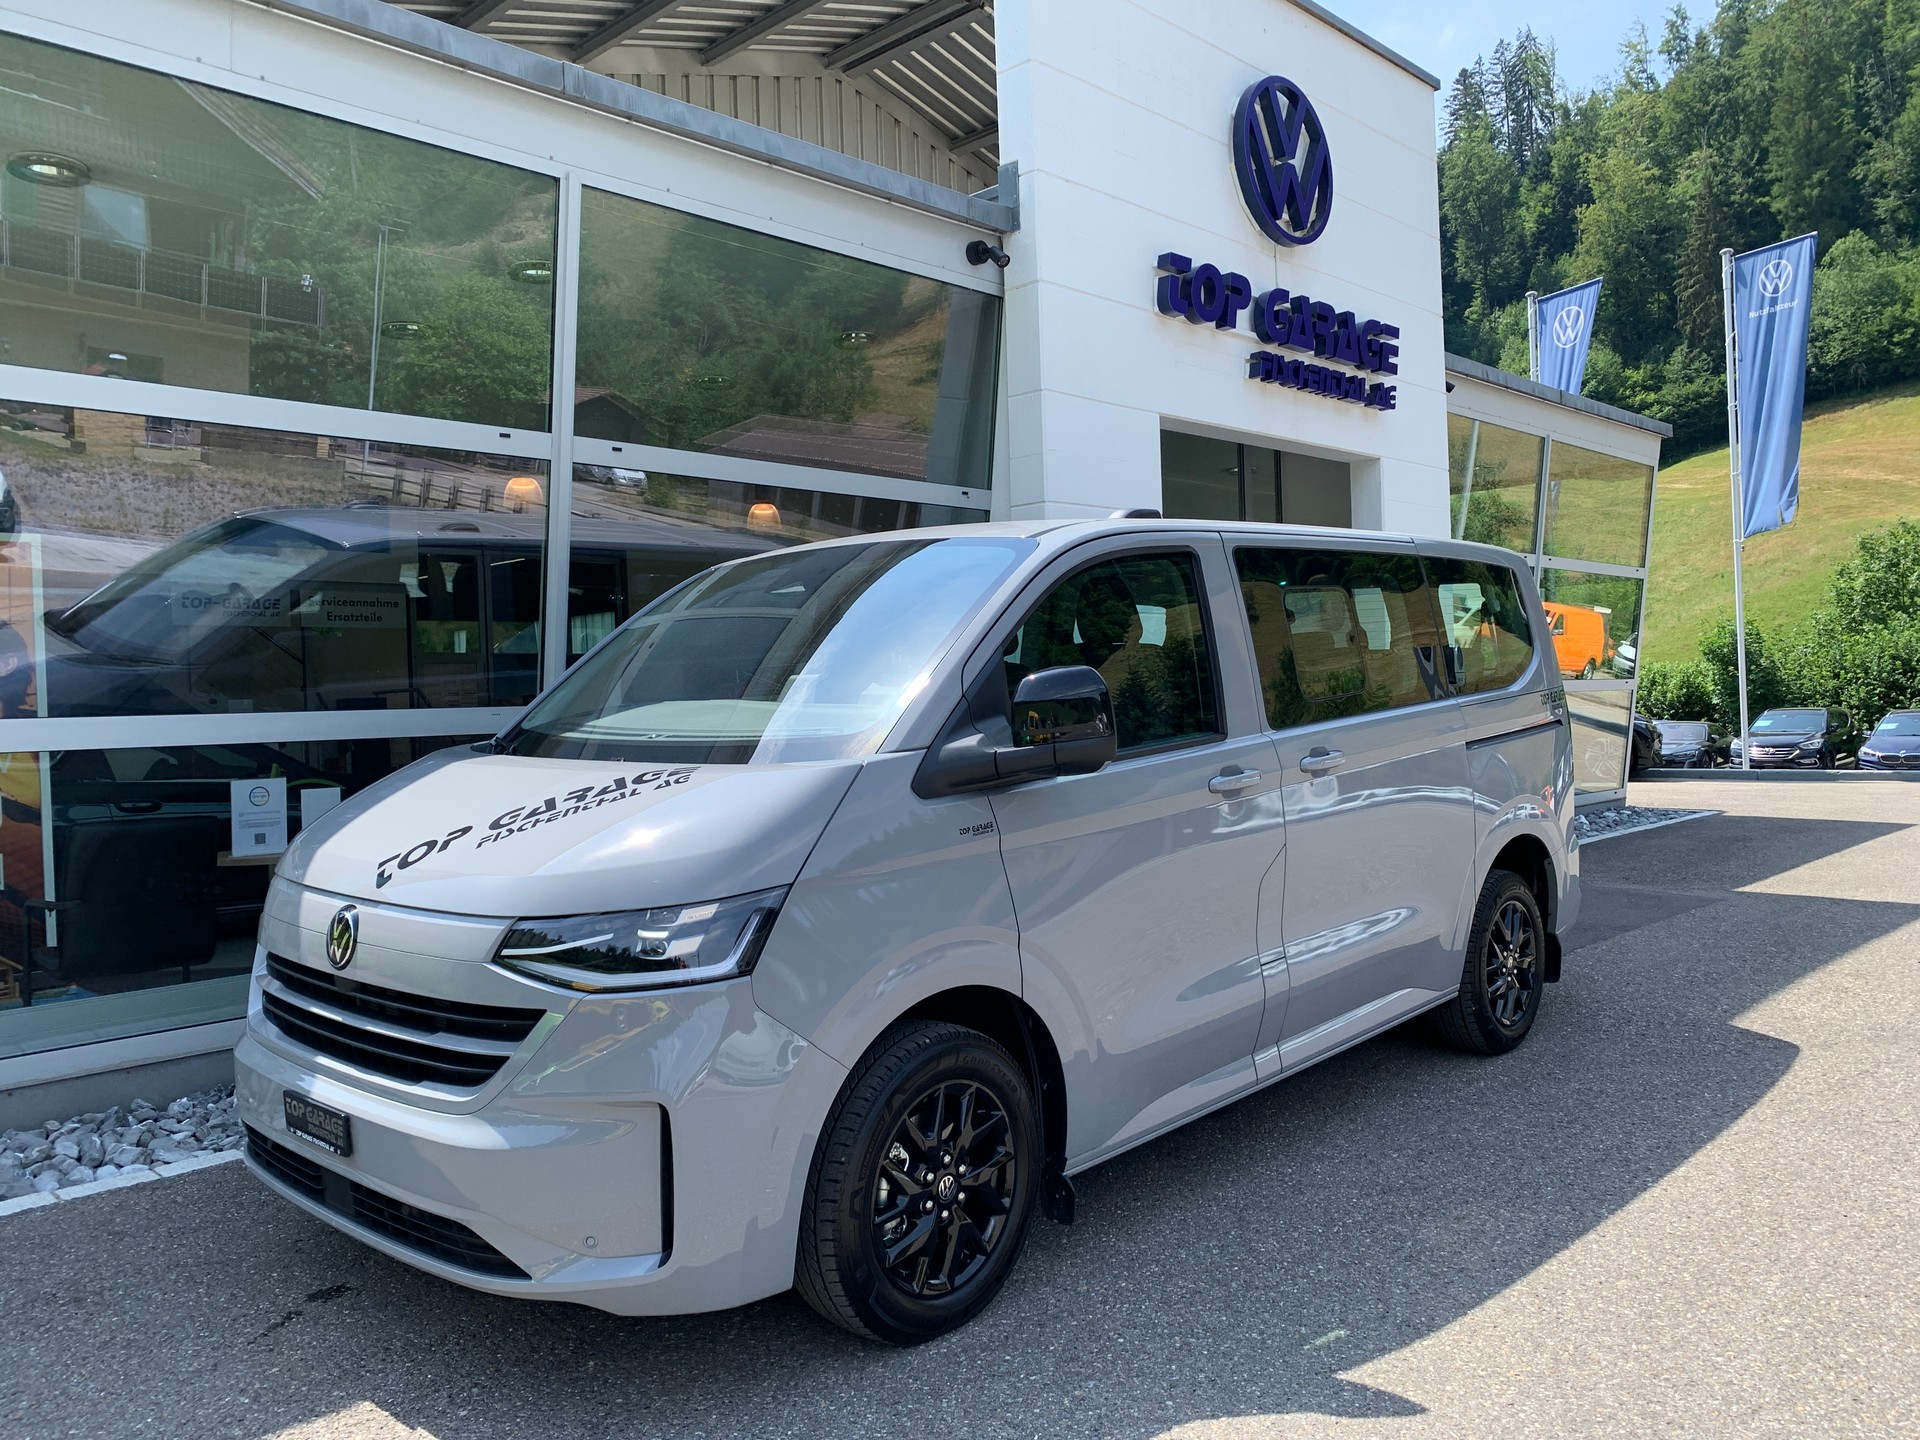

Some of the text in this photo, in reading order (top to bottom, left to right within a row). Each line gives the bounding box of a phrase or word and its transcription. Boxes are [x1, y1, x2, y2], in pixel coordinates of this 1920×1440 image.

[1233, 75, 1334, 247] VW
[1758, 259, 1793, 297] VW
[1157, 252, 1400, 377] TOP GARAGE
[1552, 305, 1585, 348] VW
[1249, 350, 1397, 411] FISCHENTHAL AG
[326, 611, 384, 623] Ersatzteile
[376, 766, 702, 889] TOP GARAGE
[475, 774, 692, 850] FISCHENTHAL AG
[959, 826, 971, 836] TOP
[972, 821, 994, 833] GARAGE
[285, 1097, 305, 1118] TOP
[305, 1106, 344, 1137] GARAGE
